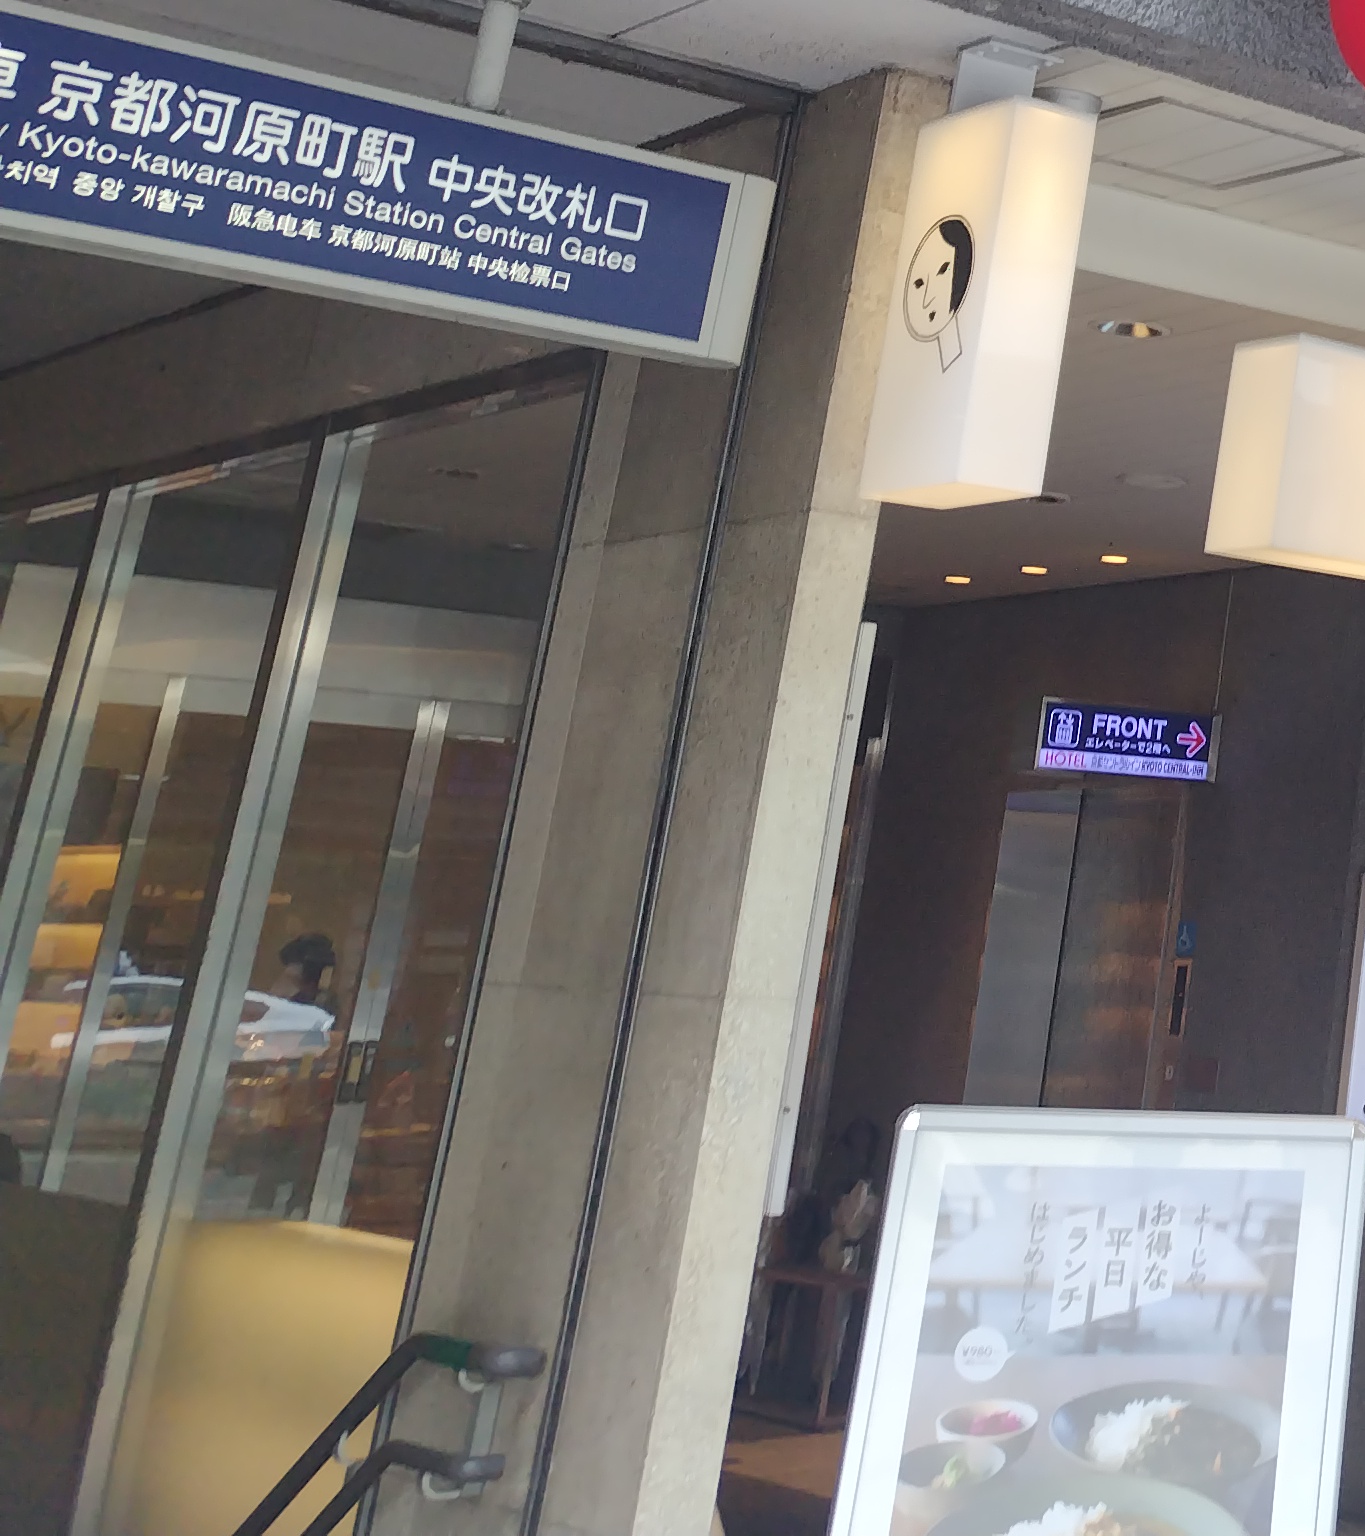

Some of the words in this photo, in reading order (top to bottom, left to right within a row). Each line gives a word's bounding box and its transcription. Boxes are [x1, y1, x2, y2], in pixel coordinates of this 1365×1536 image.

[0, 155, 60, 191] 치역
[72, 171, 126, 202] 중앙
[131, 184, 205, 218] 개찰구
[37, 59, 416, 194] 京都河原町駅
[429, 154, 649, 241] 中央改札口
[17, 121, 337, 211] Kyoto-kawaramachi
[344, 190, 444, 234] Station
[454, 214, 553, 256] Central
[561, 237, 637, 273] Gates
[226, 202, 322, 241] 阪急电车
[328, 224, 462, 271] 京都河原町站
[467, 252, 571, 292] 中央检票口
[1045, 749, 1087, 769] HOTEL
[1092, 714, 1168, 740] FRONT
[1058, 1226, 1088, 1312] ランチ
[1104, 1227, 1133, 1287] 平日
[1143, 1199, 1177, 1292] お得な
